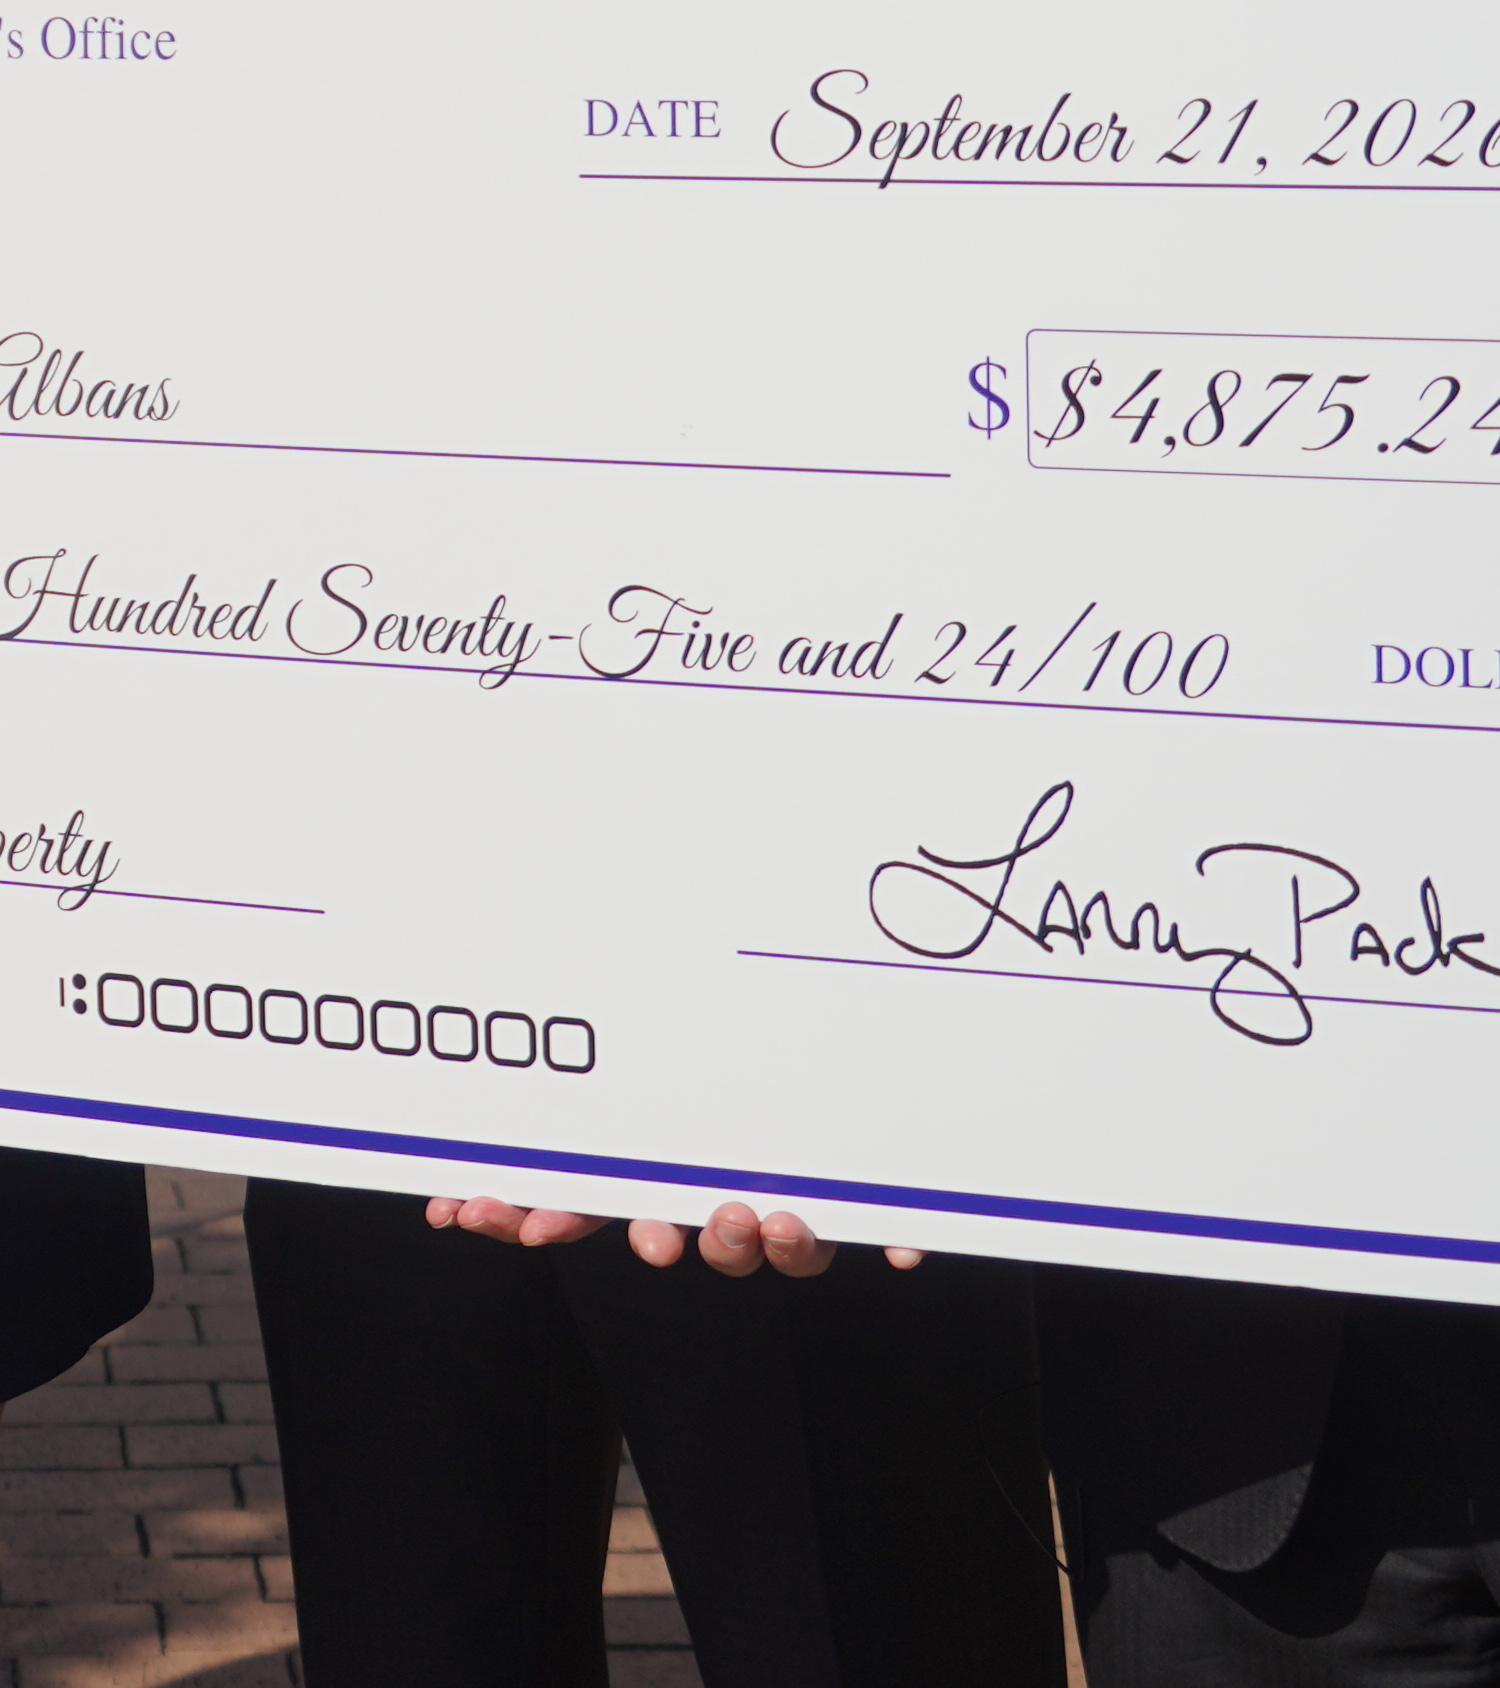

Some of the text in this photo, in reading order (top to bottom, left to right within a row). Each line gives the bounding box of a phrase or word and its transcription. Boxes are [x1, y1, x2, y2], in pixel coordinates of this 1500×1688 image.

[40, 16, 176, 61] Office
[584, 99, 722, 138] DATE
[769, 68, 1135, 190] September
[1155, 97, 1268, 175] 21,
[967, 355, 1011, 441] $
[285, 562, 757, 690] Seventy-Five
[778, 612, 905, 681] and
[916, 601, 1230, 699] 24/100
